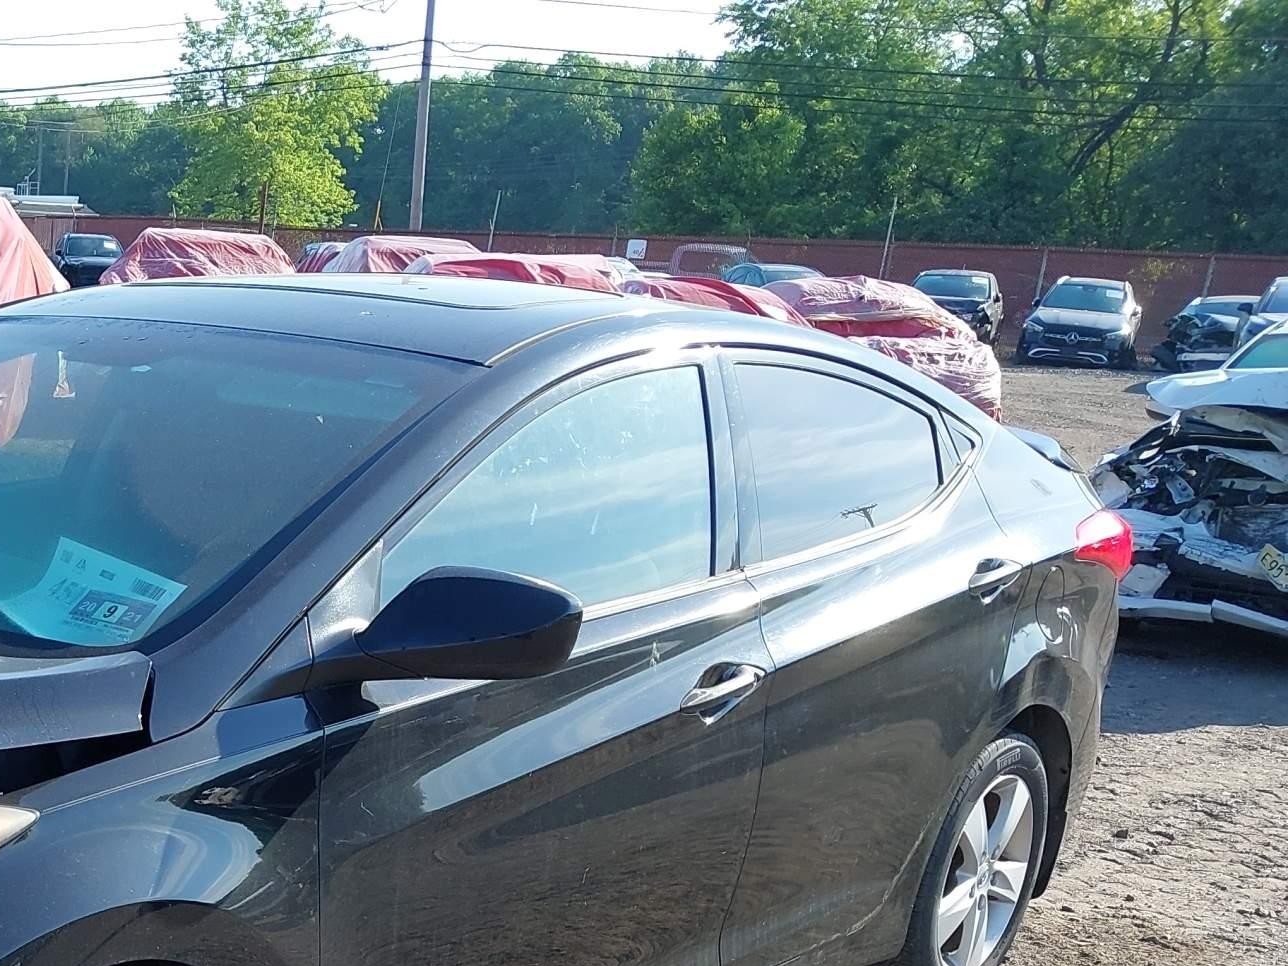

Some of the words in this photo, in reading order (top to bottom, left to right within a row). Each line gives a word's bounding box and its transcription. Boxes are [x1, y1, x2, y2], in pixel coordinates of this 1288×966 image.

[79, 600, 97, 612] 20
[102, 604, 118, 619] 9
[123, 611, 143, 623] 21
[996, 747, 1021, 771] PIRELLI
